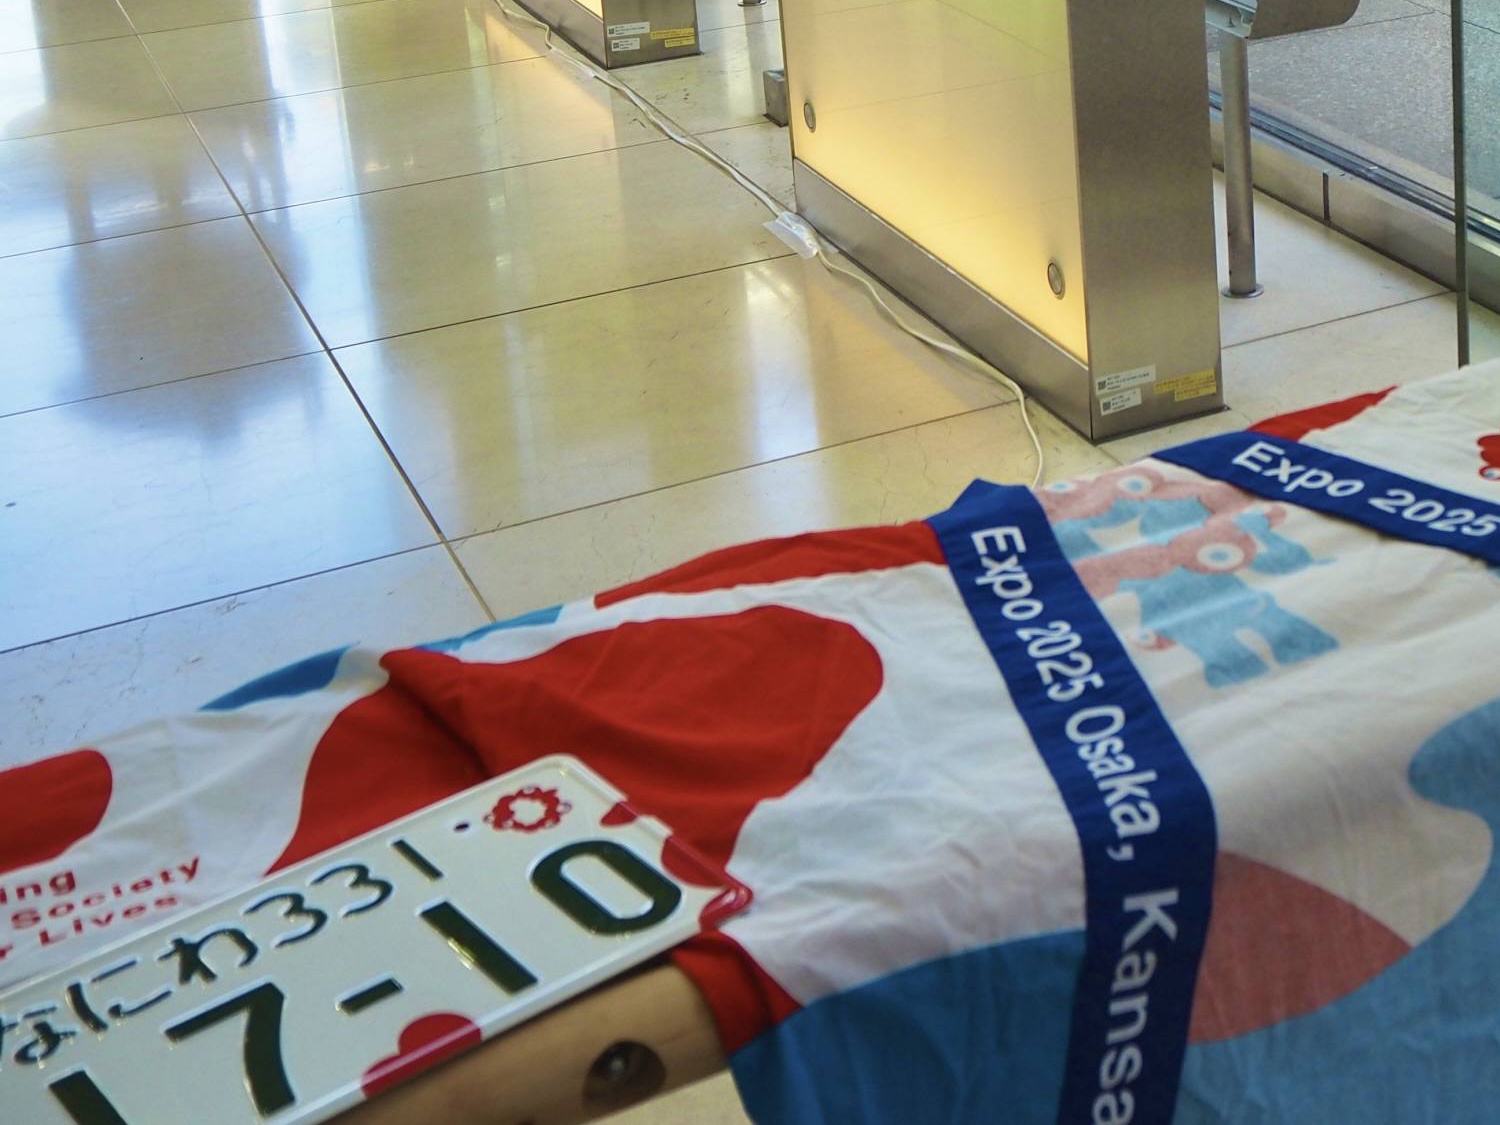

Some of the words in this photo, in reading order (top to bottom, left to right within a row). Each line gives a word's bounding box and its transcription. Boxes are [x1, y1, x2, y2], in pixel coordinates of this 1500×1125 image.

[1231, 440, 1365, 499] Expo
[971, 525, 1044, 622] Expo
[1016, 620, 1104, 702] 2025
[1065, 705, 1162, 862] Osaka,
[11, 855, 199, 929] Society
[39, 896, 178, 946] Lives
